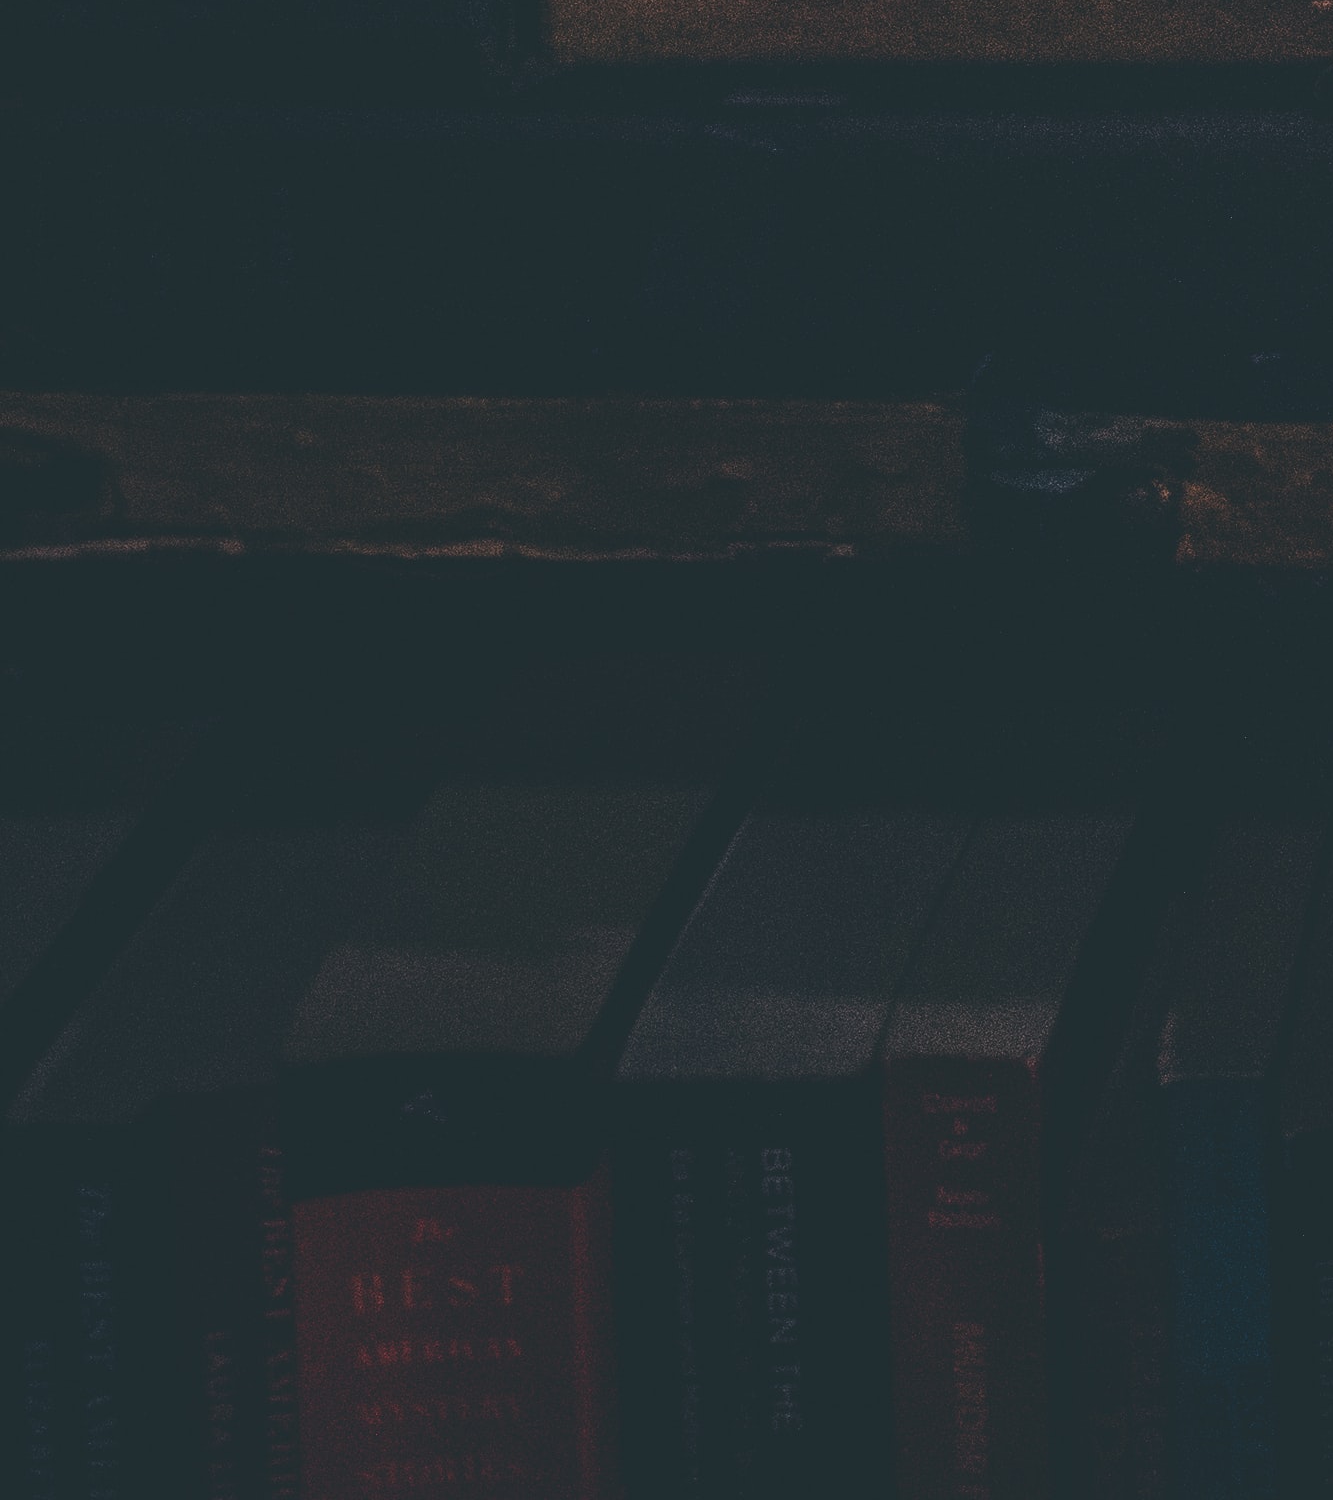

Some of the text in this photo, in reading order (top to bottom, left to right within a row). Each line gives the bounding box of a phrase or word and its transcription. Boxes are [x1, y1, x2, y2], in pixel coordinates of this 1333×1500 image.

[80, 1259, 119, 1374] BEST
[347, 1264, 527, 1318] BEST
[758, 1146, 806, 1434] BETWEEN THE
[203, 1328, 238, 1452] LAURA
[353, 1337, 526, 1369] AMERICAN
